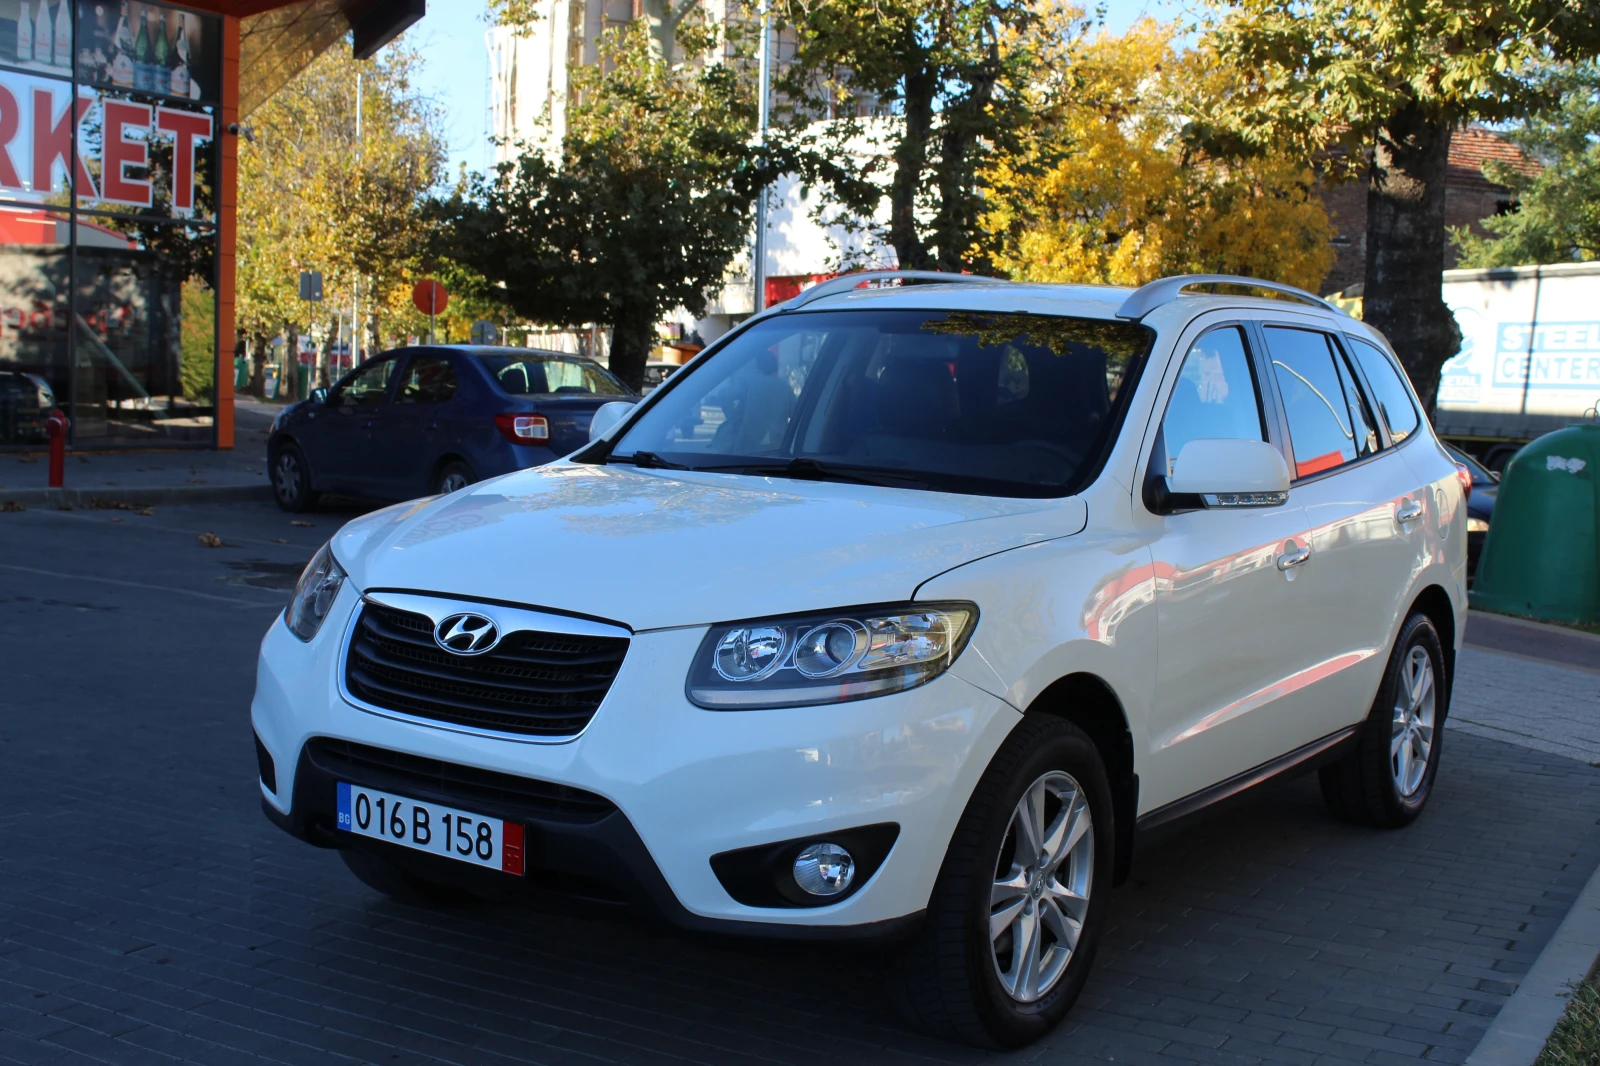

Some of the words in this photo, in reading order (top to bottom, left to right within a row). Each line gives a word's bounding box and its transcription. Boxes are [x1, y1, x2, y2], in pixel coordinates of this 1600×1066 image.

[1502, 325, 1600, 351] STEEL
[1502, 358, 1600, 379] CENTER
[338, 811, 351, 825] BG
